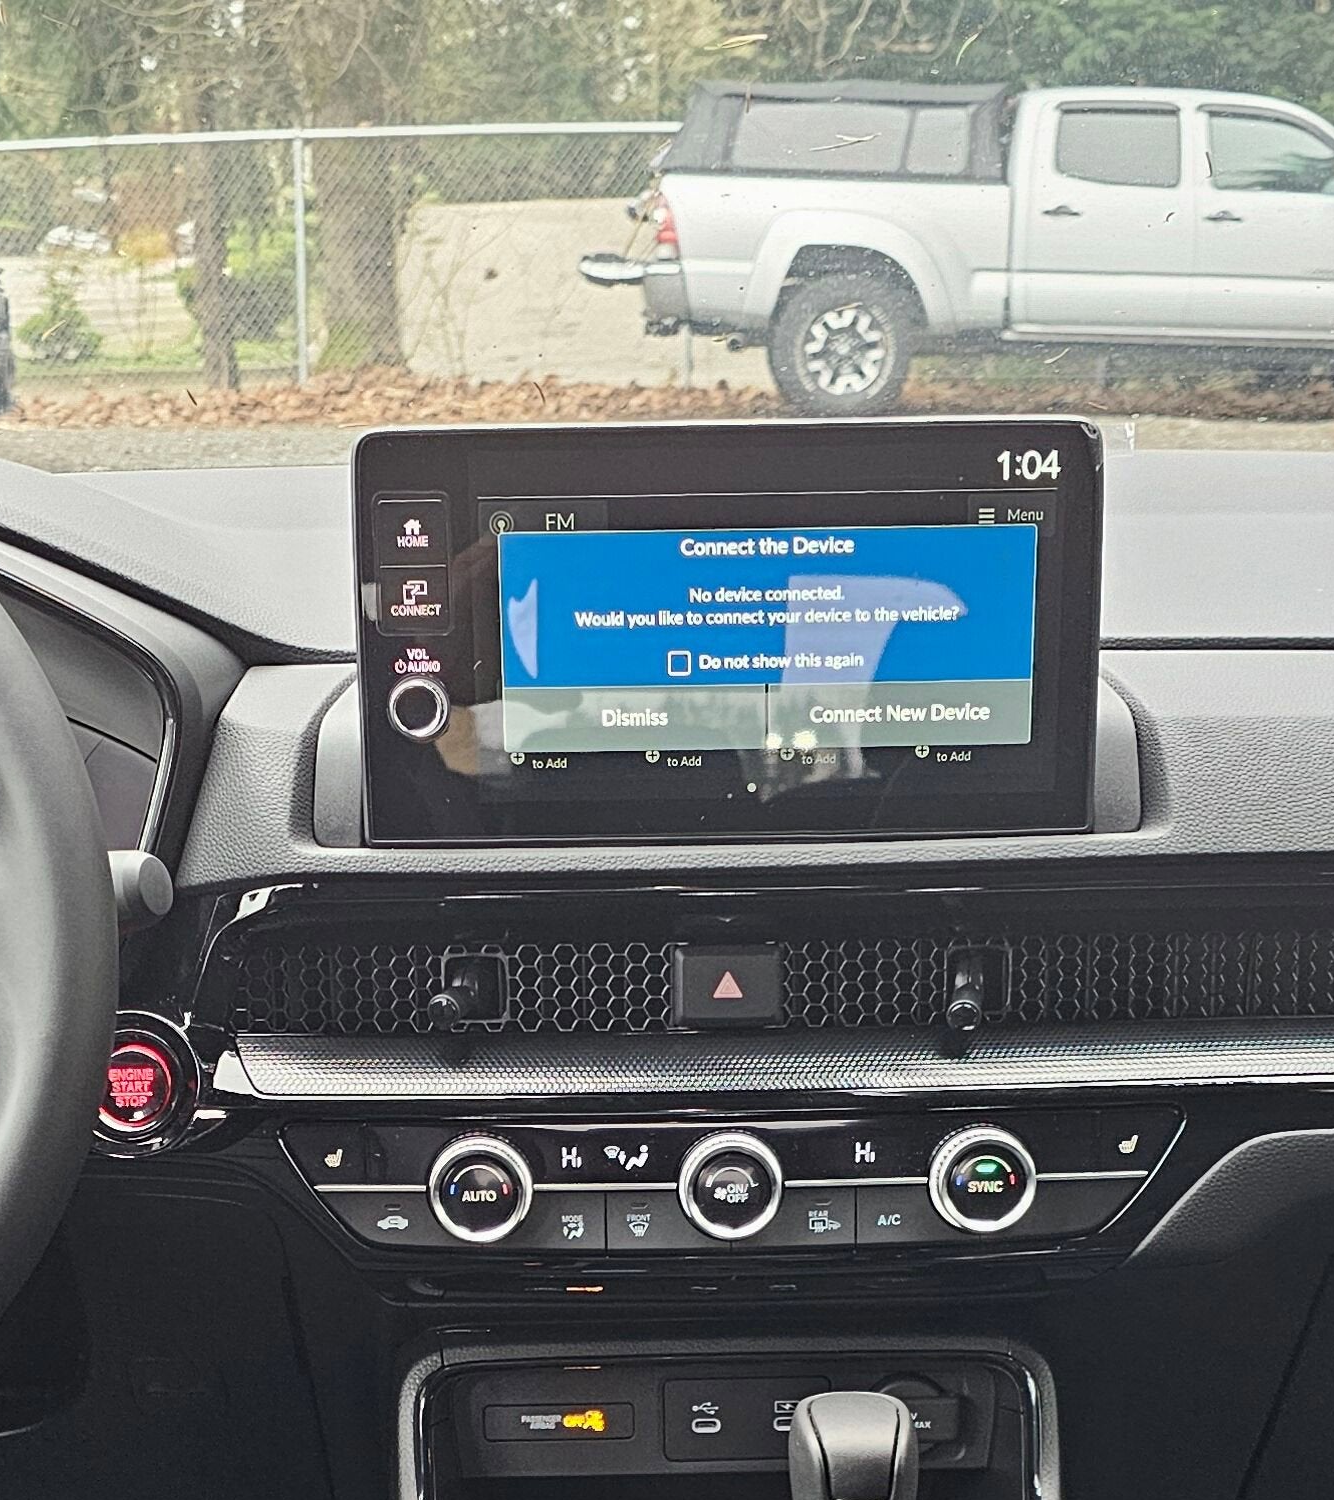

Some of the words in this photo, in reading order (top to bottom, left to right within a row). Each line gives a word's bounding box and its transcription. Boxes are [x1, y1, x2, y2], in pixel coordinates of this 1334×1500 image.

[997, 450, 1061, 480] 1:04
[1007, 509, 1043, 521] Menu
[545, 513, 575, 530] FM
[397, 536, 428, 547] HOME
[680, 539, 756, 557] Connect
[759, 537, 788, 554] the
[793, 536, 855, 554] Device
[689, 588, 713, 603] No
[714, 586, 762, 602] device
[765, 585, 845, 601] connected.
[391, 604, 441, 616] CONNECT
[574, 611, 624, 628] Would
[628, 614, 655, 629] you
[658, 611, 683, 625] like
[686, 611, 703, 625] to
[705, 610, 764, 624] connect
[768, 609, 801, 627] your
[804, 607, 852, 623] device
[854, 606, 872, 623] to
[873, 606, 899, 622] the
[901, 605, 960, 622] vehicle?
[407, 649, 429, 660] VOL
[698, 654, 721, 670] Do
[723, 653, 751, 669] not
[752, 653, 791, 668] show
[794, 651, 822, 668] this
[825, 652, 865, 669] again
[407, 661, 441, 672] AUDIO
[602, 709, 668, 727] Dismiss
[809, 705, 882, 724] Connect
[886, 705, 928, 722] New
[930, 703, 991, 721] Device
[667, 757, 679, 767] to
[680, 757, 702, 767] Add
[802, 755, 813, 765] to
[815, 754, 836, 764] Add
[936, 752, 948, 762] to
[950, 752, 971, 761] Add
[532, 759, 544, 769] to
[546, 759, 567, 769] Add
[109, 1069, 153, 1081] ENGINE
[112, 1081, 151, 1092] START
[115, 1097, 147, 1108] STOP
[726, 1184, 748, 1194] ON/
[967, 1181, 1003, 1193] SYNC
[461, 1190, 497, 1202] AUTO
[726, 1194, 748, 1203] OFF
[562, 1215, 583, 1223] MODE
[627, 1213, 651, 1222] FRONT
[809, 1210, 829, 1218] REAR
[877, 1214, 901, 1226] A/C
